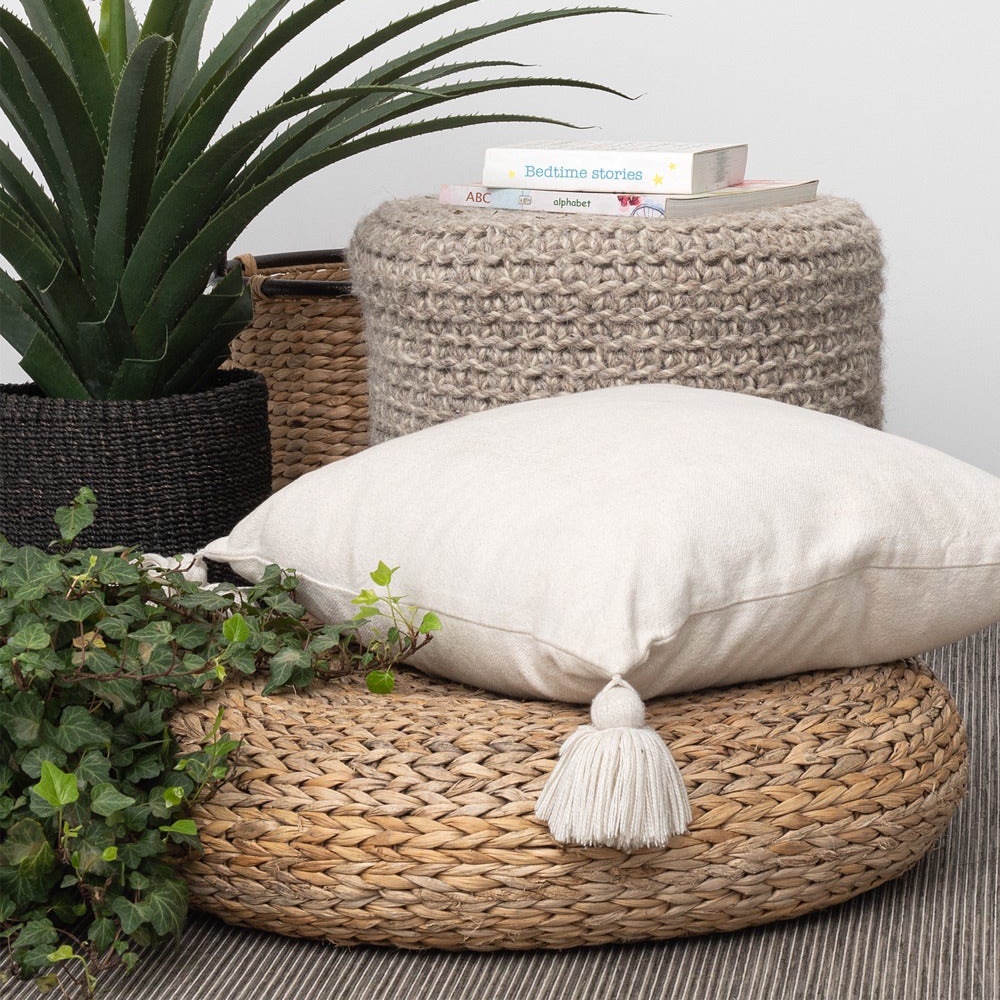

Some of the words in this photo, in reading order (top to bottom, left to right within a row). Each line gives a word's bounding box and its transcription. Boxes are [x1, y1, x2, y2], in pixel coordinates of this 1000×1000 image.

[524, 165, 588, 179] Bedtime
[591, 167, 643, 181] stories
[465, 191, 492, 204] ABC
[553, 198, 592, 209] alphabet
